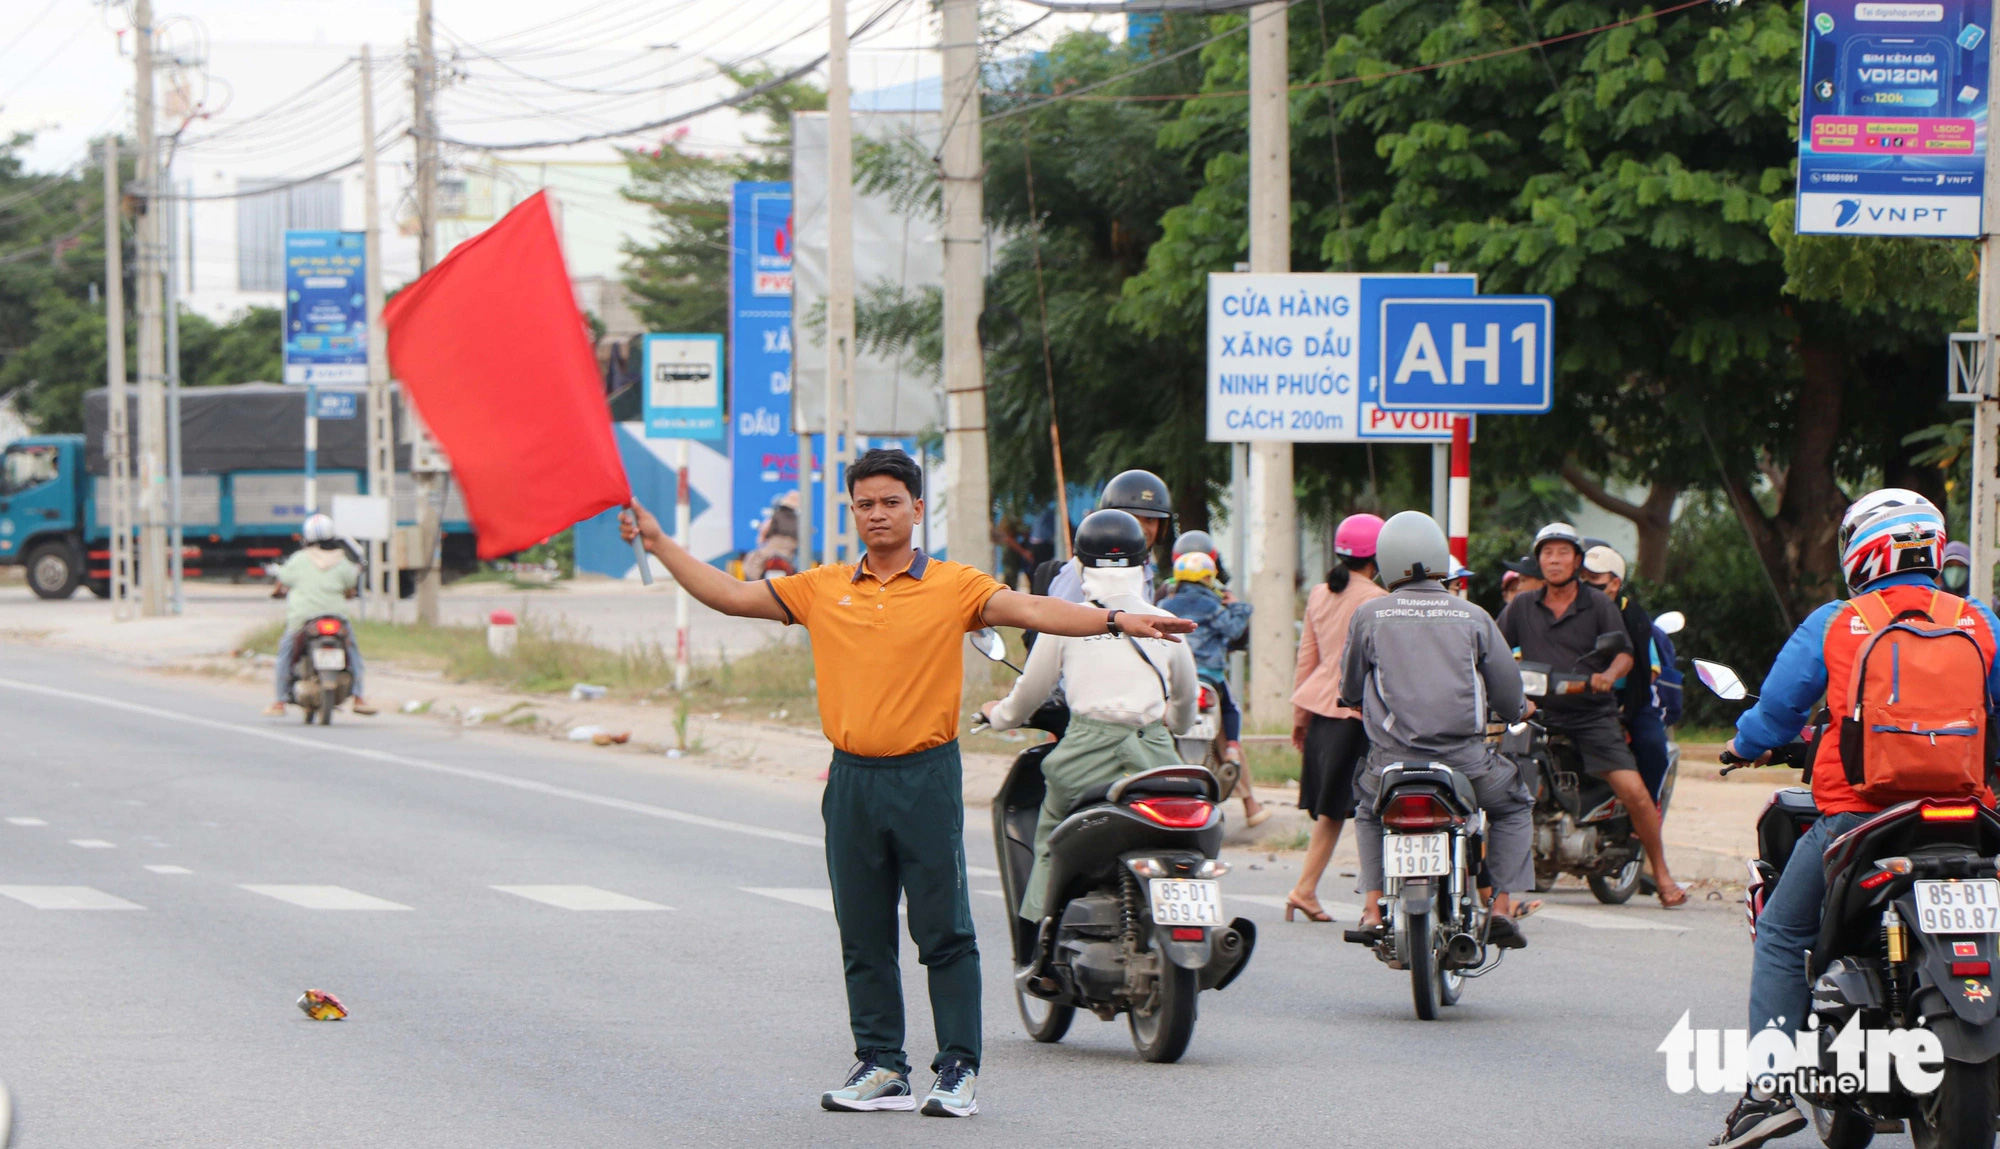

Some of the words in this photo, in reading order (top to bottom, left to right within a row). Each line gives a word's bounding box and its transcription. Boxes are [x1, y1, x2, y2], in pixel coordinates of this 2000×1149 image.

[1863, 53, 1884, 63] SIM
[1858, 68, 1938, 82] VD120M
[1875, 92, 1903, 103] 120k
[1814, 123, 1858, 135] 30GB
[1946, 176, 1973, 184] VNPT
[1868, 207, 1948, 223] VNPT
[1222, 288, 1271, 317] CỬA
[1279, 289, 1350, 317] HÀNG
[1221, 331, 1293, 357] XĂNG
[1393, 321, 1537, 386] AH1
[1219, 374, 1269, 395] NINH
[1276, 366, 1350, 395] PHƯỚC
[1226, 405, 1285, 429] CÁCH
[1290, 409, 1344, 429] 200m
[1370, 409, 1455, 430] PVOIL
[1396, 598, 1449, 607] TRUNGNAM
[1374, 608, 1425, 618] TECHNICAL
[1426, 609, 1470, 619] SERVICES
[1396, 855, 1441, 874] 1902
[1161, 883, 1208, 901] 85-D1
[1928, 883, 1987, 905] 85-B1
[1157, 903, 1218, 922] 569.41
[1924, 907, 1998, 929] 968.87
